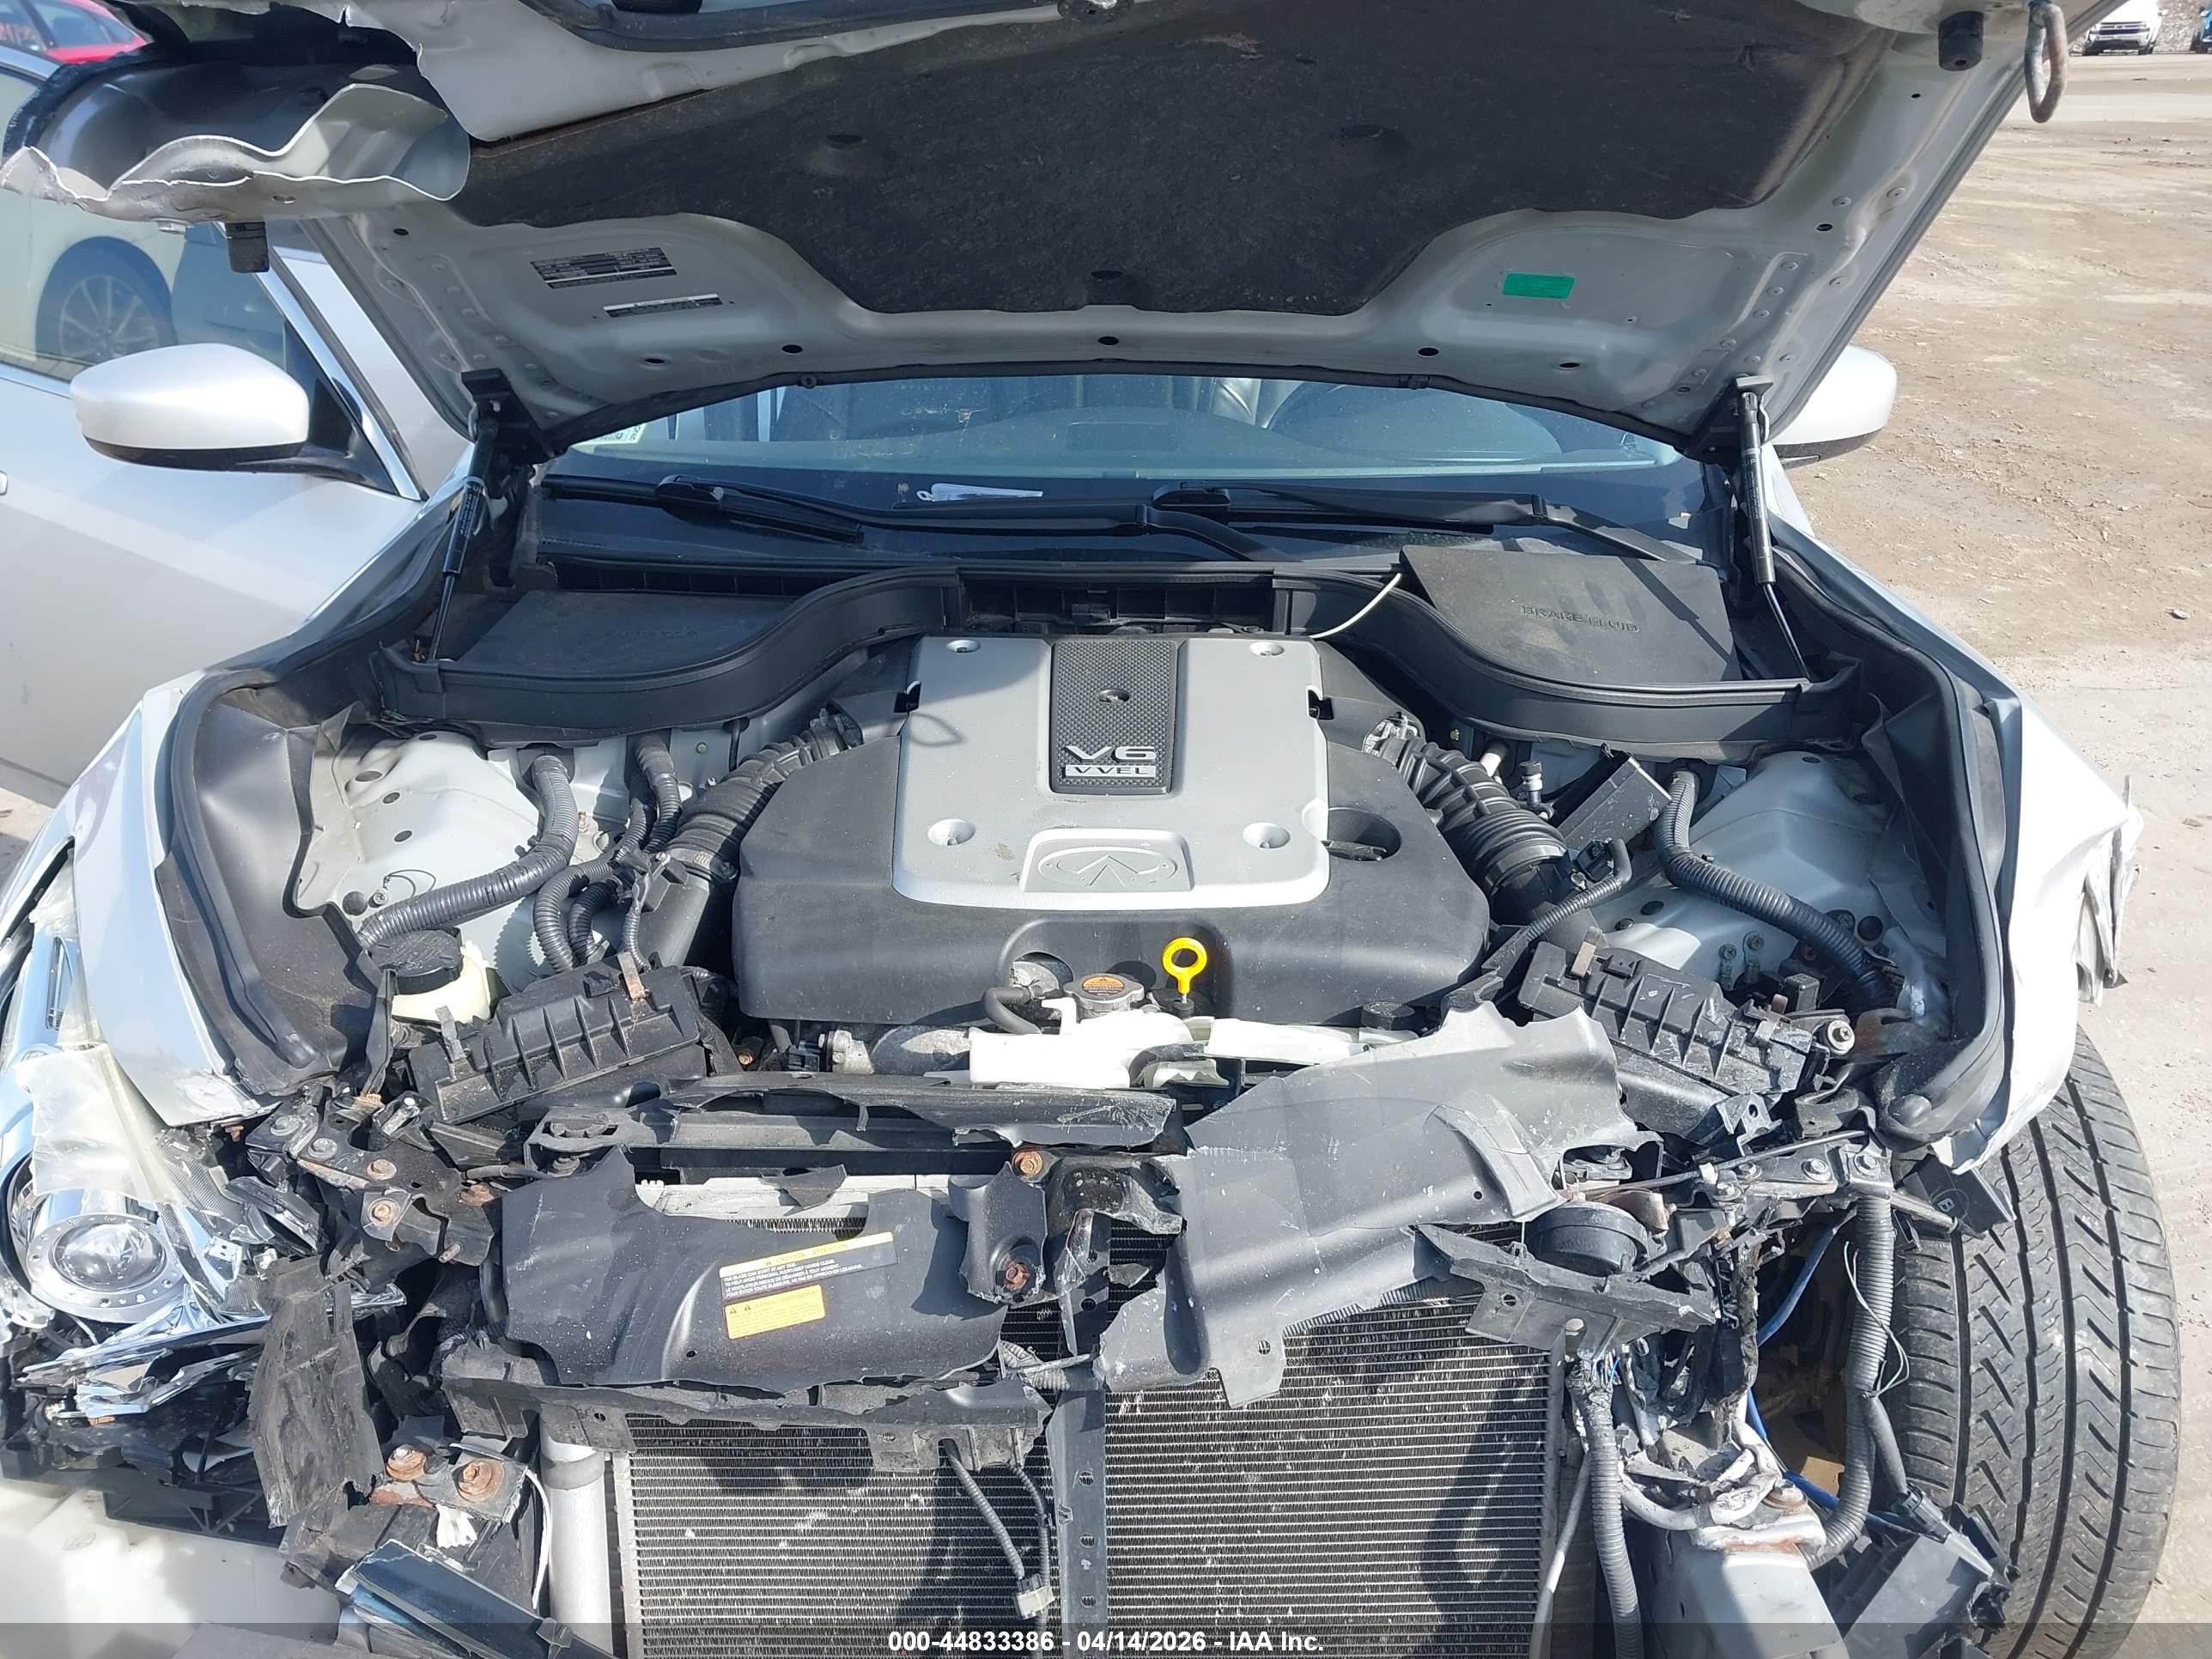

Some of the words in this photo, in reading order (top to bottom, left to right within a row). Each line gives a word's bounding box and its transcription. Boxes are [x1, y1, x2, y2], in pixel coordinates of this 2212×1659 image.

[1521, 605, 1585, 623] BRAKE
[1587, 616, 1641, 633] FLUID
[1064, 745, 1157, 763] V6
[1073, 766, 1149, 775] VVEL
